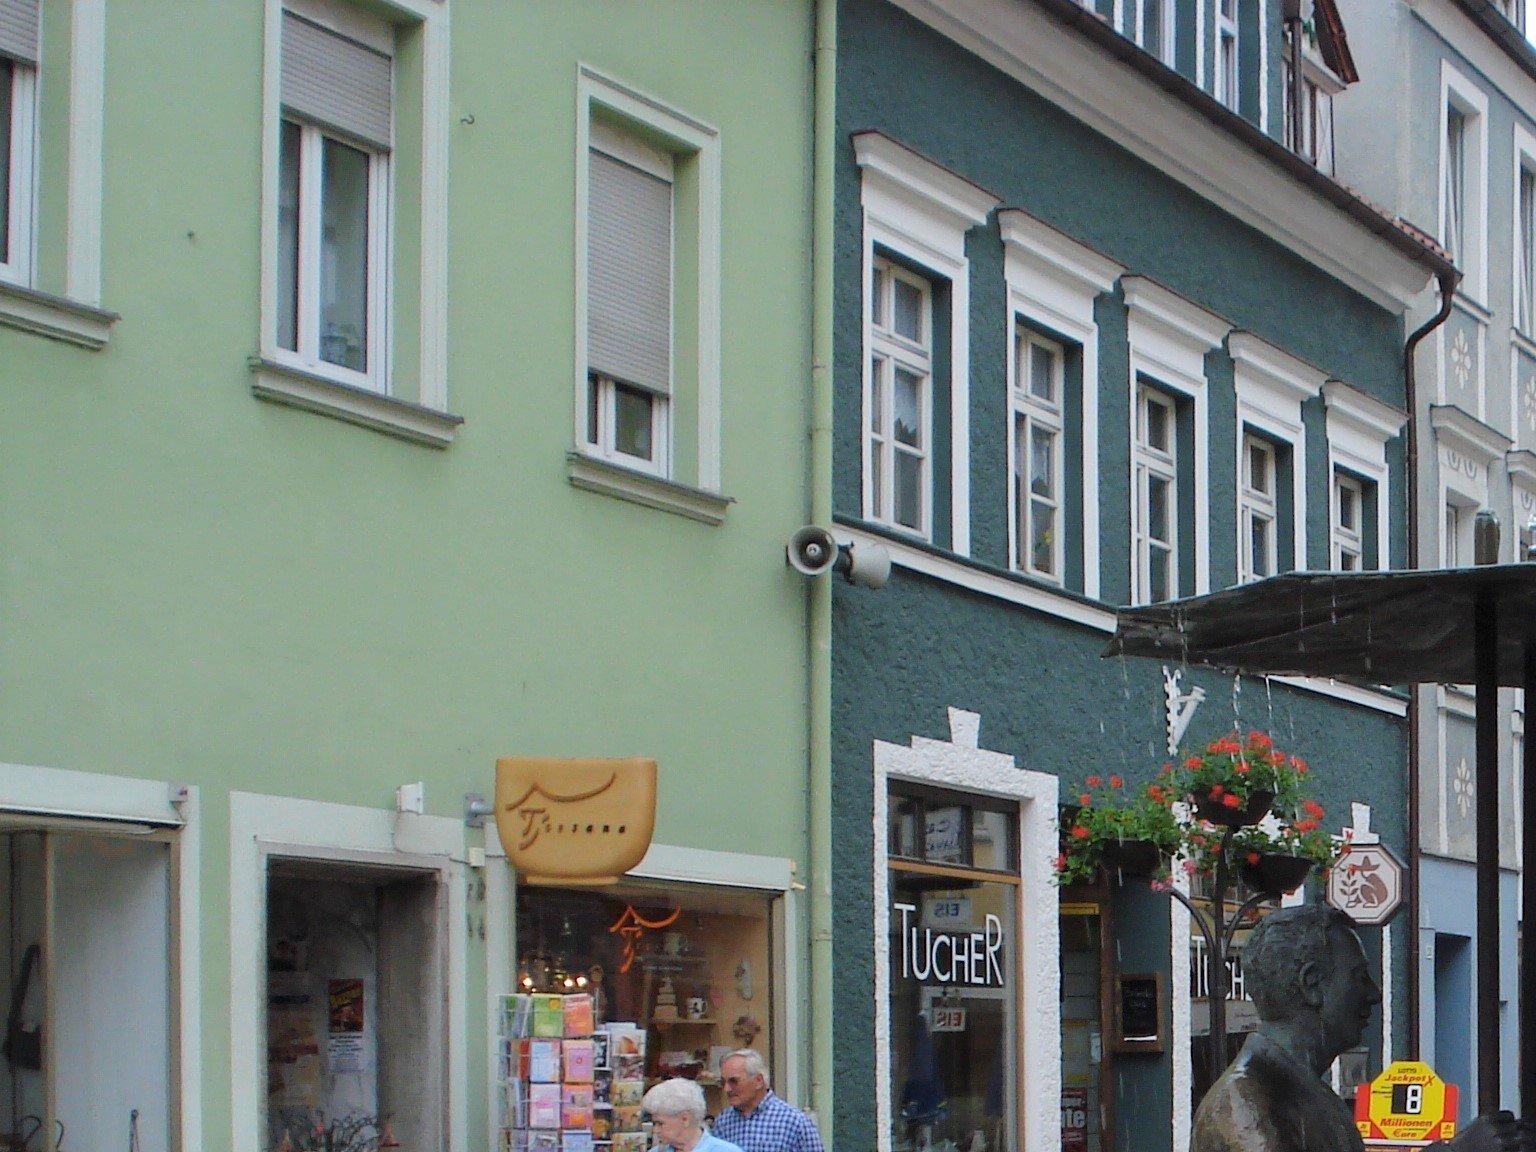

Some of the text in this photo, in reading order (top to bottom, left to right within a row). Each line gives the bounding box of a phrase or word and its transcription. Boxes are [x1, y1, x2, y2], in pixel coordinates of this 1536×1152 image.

[893, 902, 1004, 986] TUCHER
[1385, 1074, 1426, 1082] Jackpot
[1406, 1085, 1422, 1113] 8
[1380, 1118, 1433, 1127] Millionen
